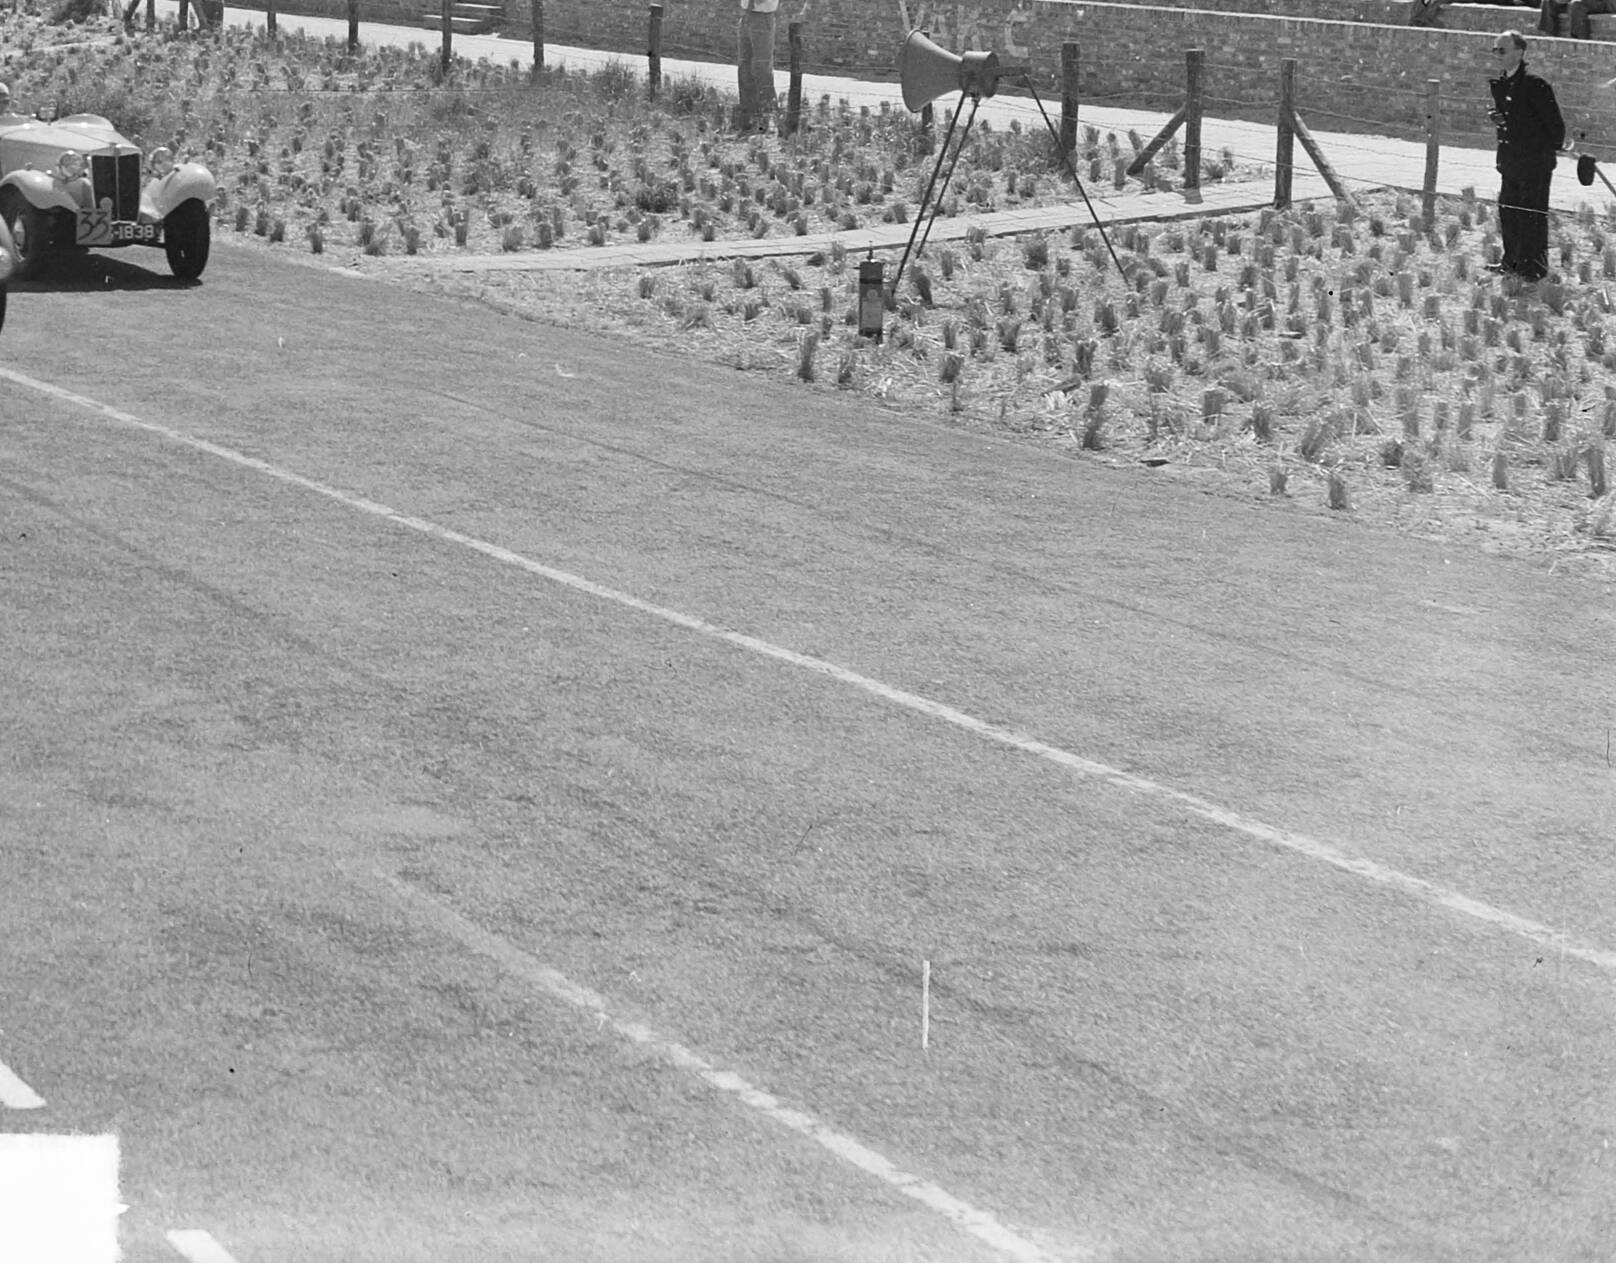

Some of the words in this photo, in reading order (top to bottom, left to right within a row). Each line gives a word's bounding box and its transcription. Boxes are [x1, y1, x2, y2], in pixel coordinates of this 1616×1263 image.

[899, 0, 983, 52] VAK
[1004, 8, 1036, 58] C
[77, 211, 109, 241] 33
